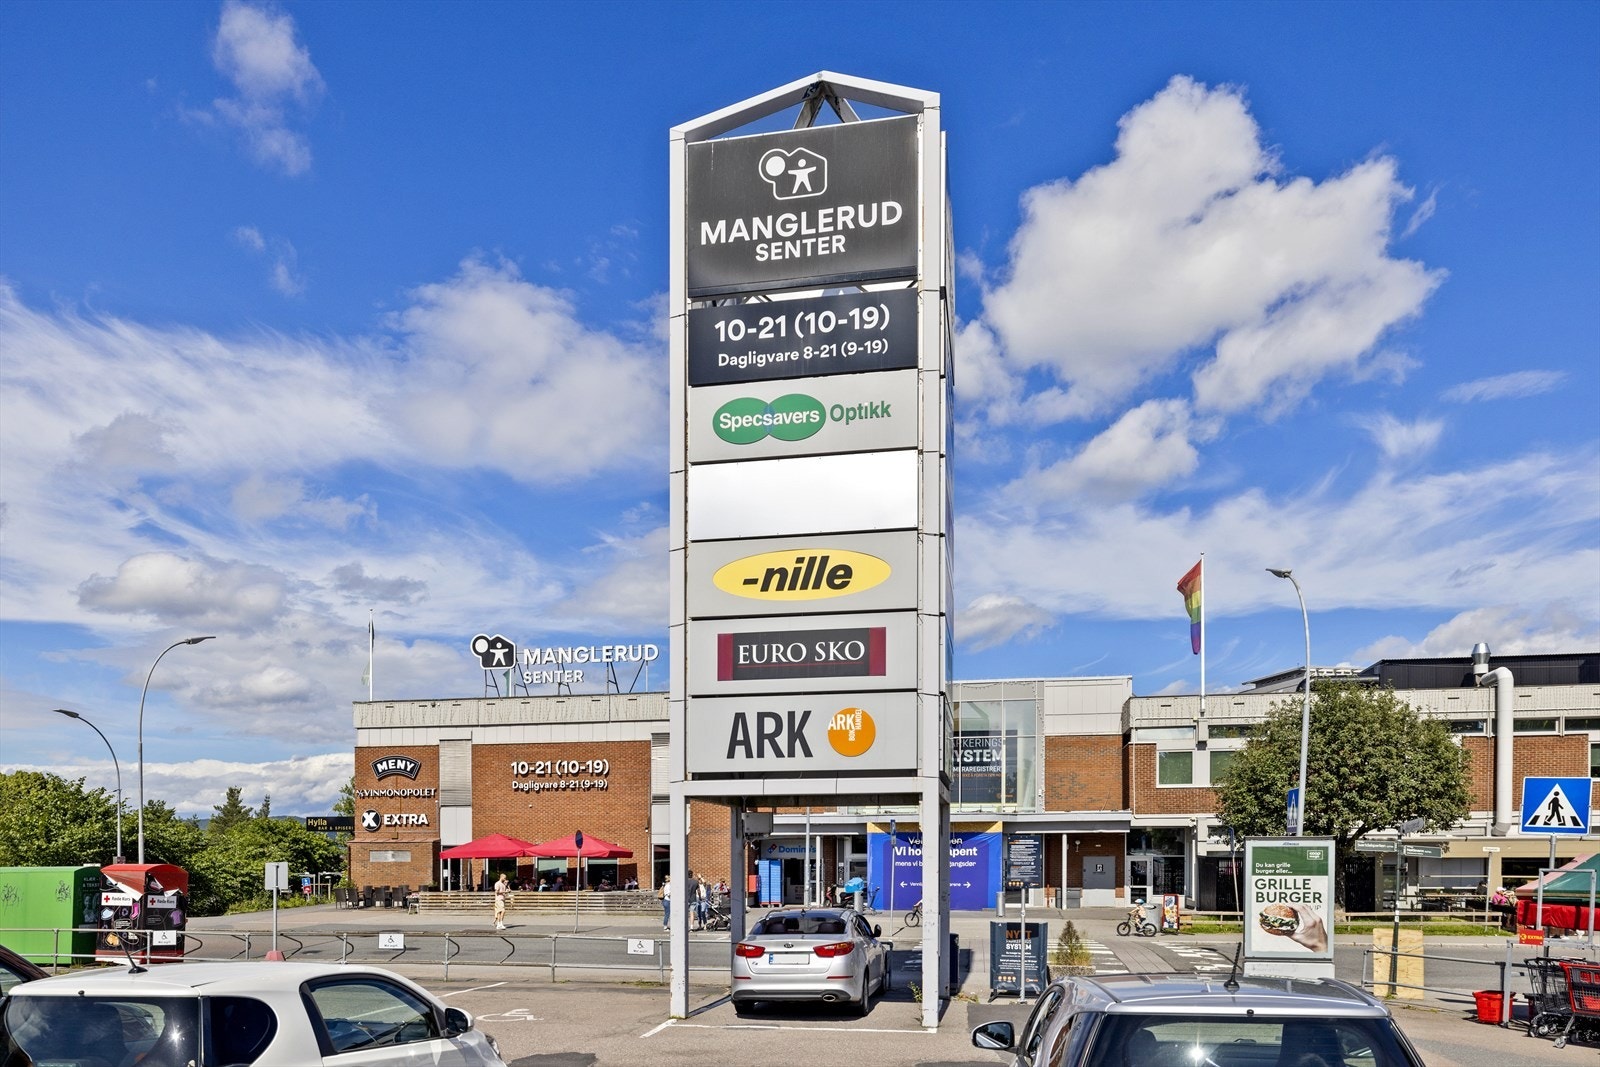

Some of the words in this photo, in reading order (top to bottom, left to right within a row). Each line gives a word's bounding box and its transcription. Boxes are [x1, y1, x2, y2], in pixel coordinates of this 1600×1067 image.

[700, 201, 902, 245] MANGLERUD
[755, 234, 845, 261] SENTER
[714, 315, 786, 342] 10-21
[794, 303, 890, 338] (10-19)
[718, 350, 799, 368] Dagligvare
[803, 343, 837, 359] 8-21
[840, 338, 889, 358] (9-19)
[719, 401, 820, 432] Specsavers
[829, 401, 892, 426] Optikk
[742, 555, 853, 593] -nille
[523, 643, 659, 666] MANGLERUD
[737, 642, 807, 665] EURO
[815, 640, 866, 662] SKO
[523, 670, 584, 685] SENTER
[828, 714, 855, 730] ARK
[726, 709, 814, 759] ARK
[952, 749, 1003, 762] YSTEM
[376, 759, 415, 773] MENY
[511, 760, 552, 776] 10-21
[555, 758, 610, 777] (10-19)
[364, 788, 436, 797] VINMONOPOLET
[512, 780, 558, 792] Dagligvare
[559, 779, 580, 789] 8-21
[580, 778, 608, 790] (9-19)
[307, 818, 328, 827] Hylla
[384, 813, 429, 825] EXTRA
[778, 845, 816, 853] Domin's
[894, 846, 906, 856] Vi
[1255, 878, 1312, 890] GRILLE
[1255, 891, 1323, 903] BURGER
[1006, 930, 1032, 939] NYT
